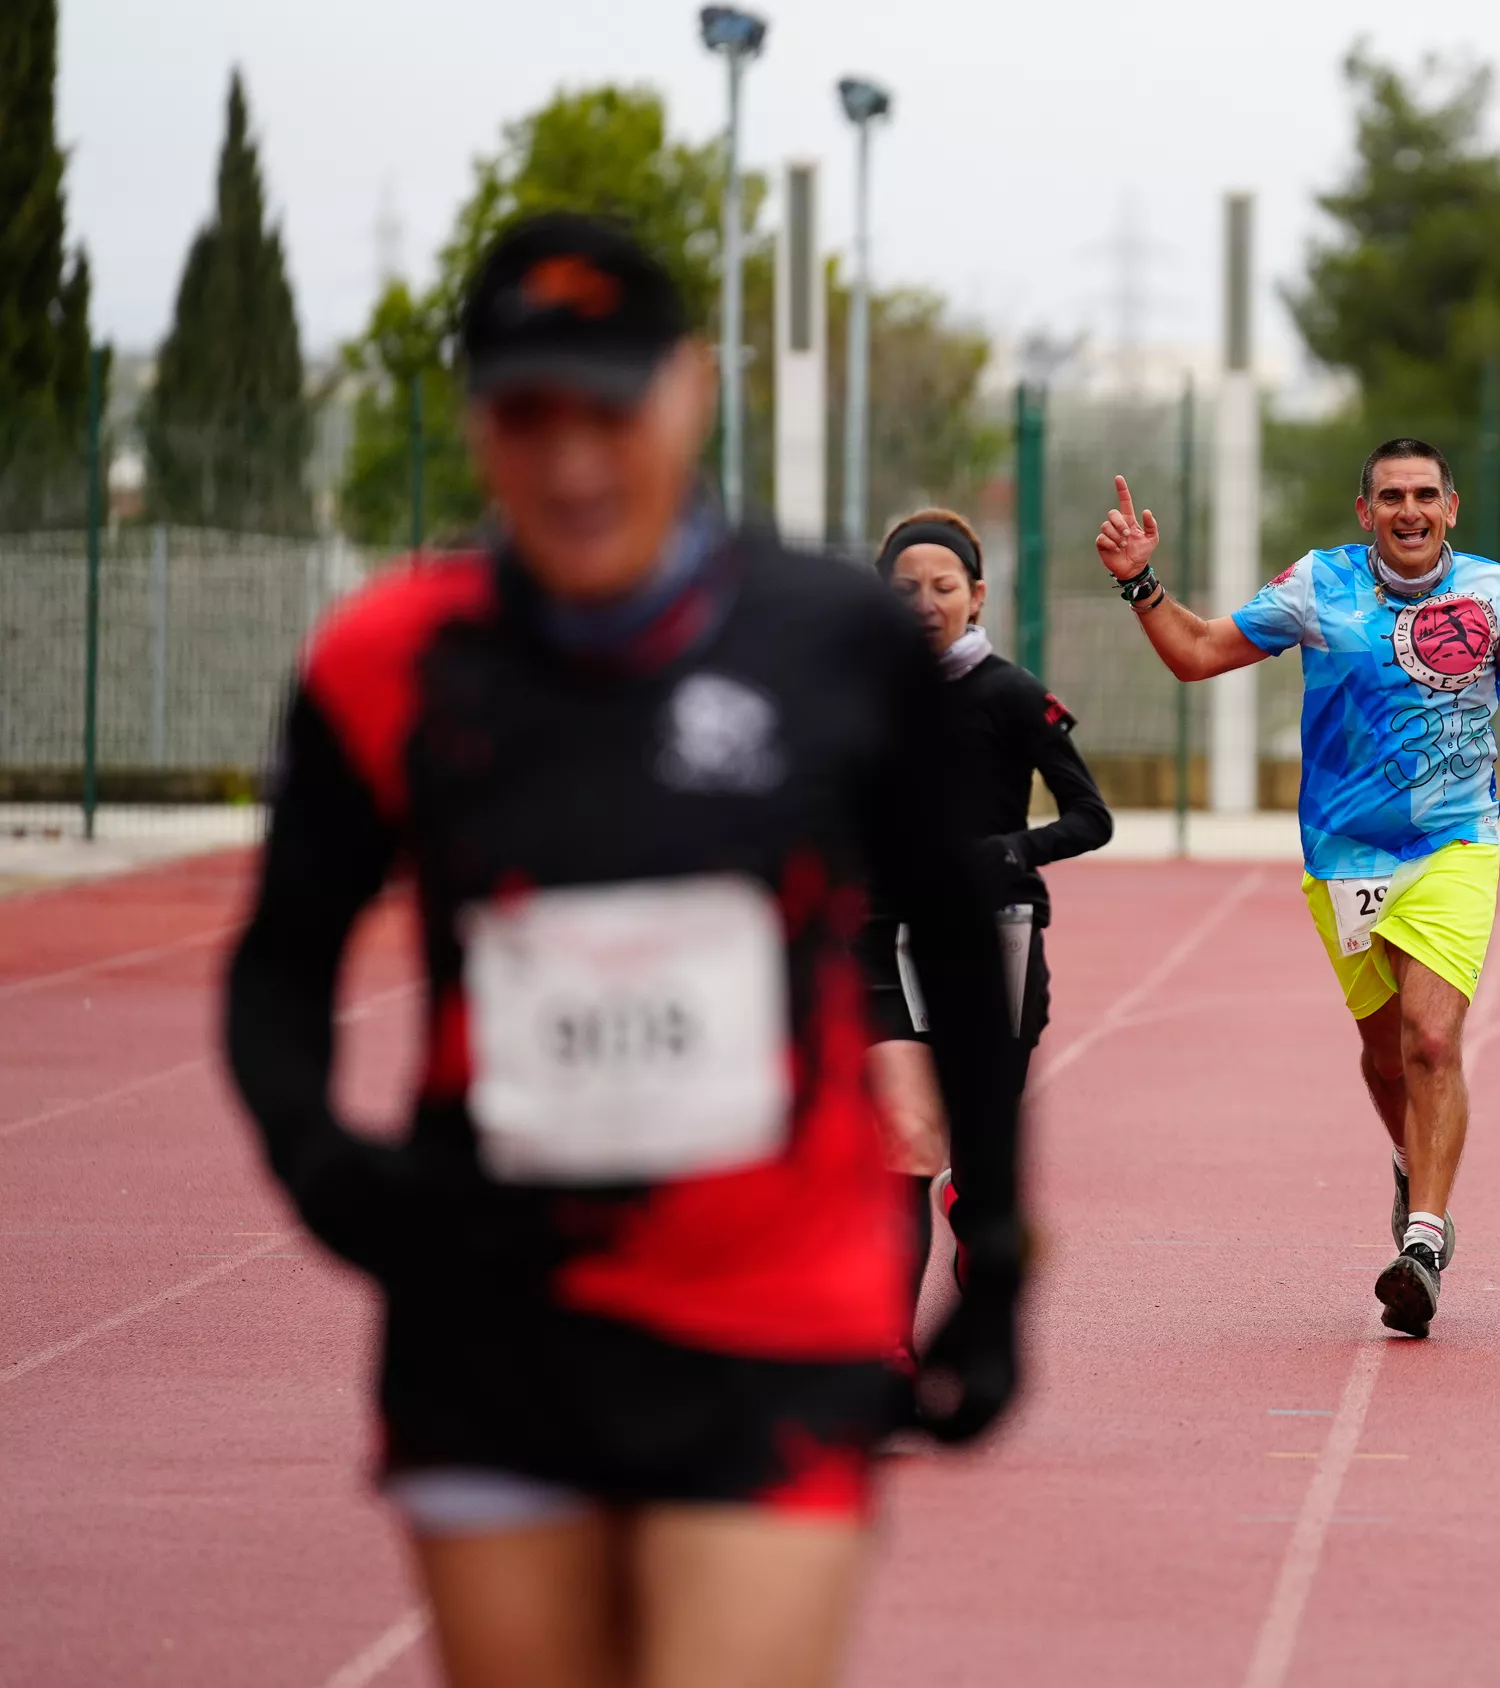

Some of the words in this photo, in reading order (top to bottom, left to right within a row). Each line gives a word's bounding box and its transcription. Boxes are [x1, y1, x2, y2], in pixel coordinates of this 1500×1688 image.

[1398, 622, 1415, 668] CLUB
[1385, 703, 1491, 791] 35
[1441, 701, 1460, 807] anivesario
